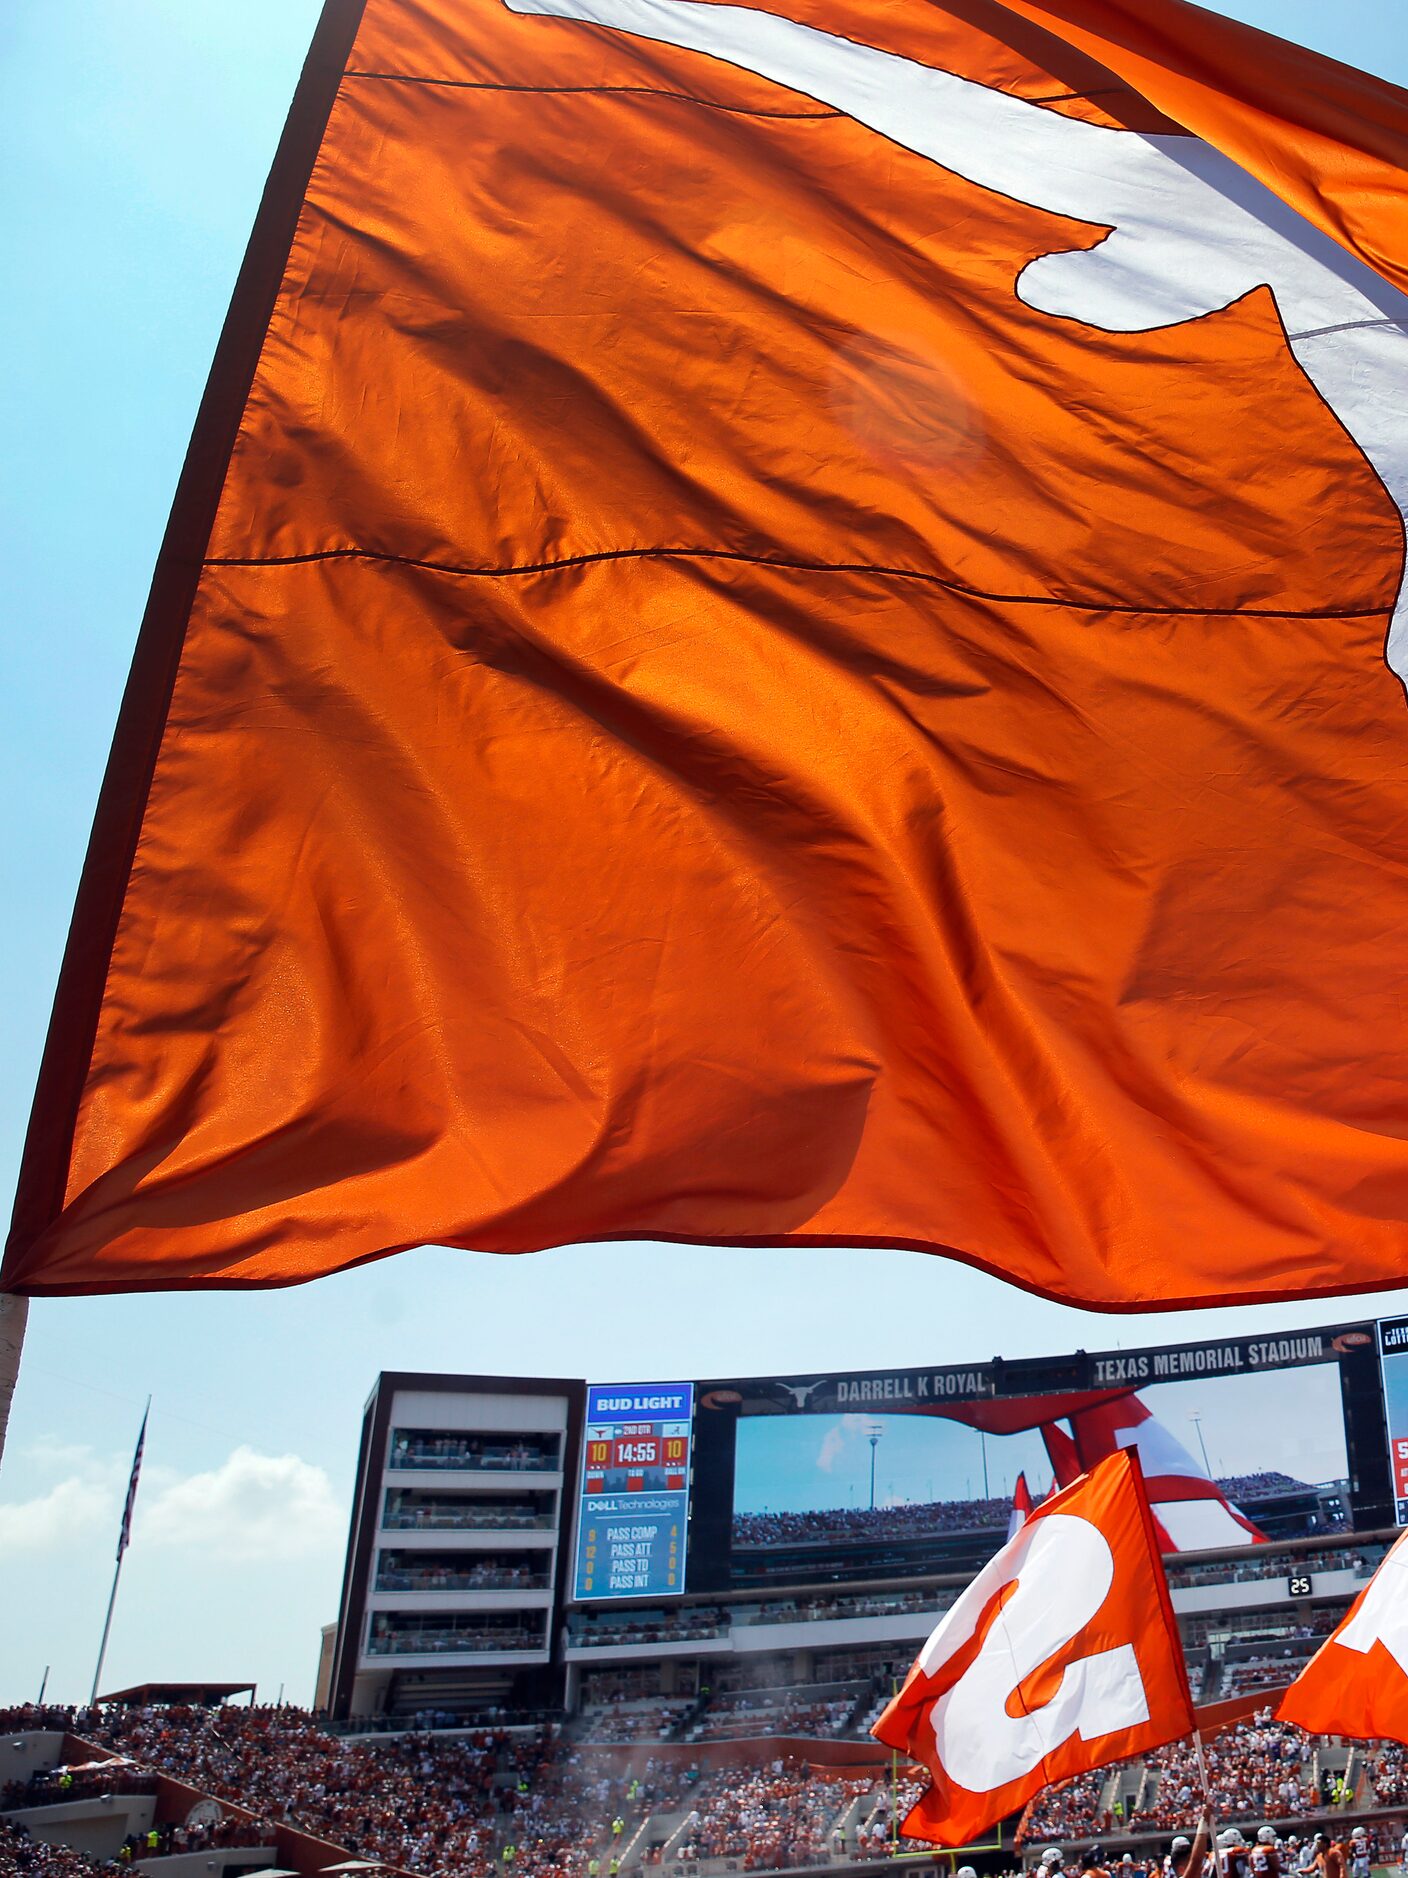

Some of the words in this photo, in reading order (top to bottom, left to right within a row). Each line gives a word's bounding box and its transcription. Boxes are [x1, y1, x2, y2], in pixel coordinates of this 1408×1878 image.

[1095, 1356, 1150, 1382] TEXAS
[1154, 1346, 1244, 1376] MEMORIAL
[1248, 1336, 1323, 1365] STADIUM
[837, 1378, 913, 1402] DARRELL
[917, 1376, 929, 1397] K
[933, 1372, 986, 1396] ROYAL
[596, 1398, 633, 1411] BUD
[633, 1396, 683, 1410] LIGHT
[623, 1425, 637, 1436] 2ND
[637, 1424, 652, 1435] QTR
[592, 1443, 607, 1462] 10
[617, 1442, 657, 1463] 14:55
[667, 1439, 682, 1458] 10
[587, 1500, 618, 1511] DELL
[618, 1498, 680, 1511] Technologies
[588, 1528, 596, 1542] 9
[607, 1527, 631, 1541] PASS
[631, 1525, 658, 1539] COMP
[670, 1524, 677, 1537] 4
[586, 1546, 597, 1558] 12
[611, 1543, 635, 1557] PASS
[635, 1542, 652, 1555] ATT
[612, 1559, 636, 1572] PASS
[636, 1558, 649, 1571] TD
[669, 1556, 677, 1570] 0
[609, 1575, 634, 1589] PASS
[634, 1574, 649, 1587] INT
[667, 1572, 676, 1586] 0
[1291, 1577, 1310, 1594] 25
